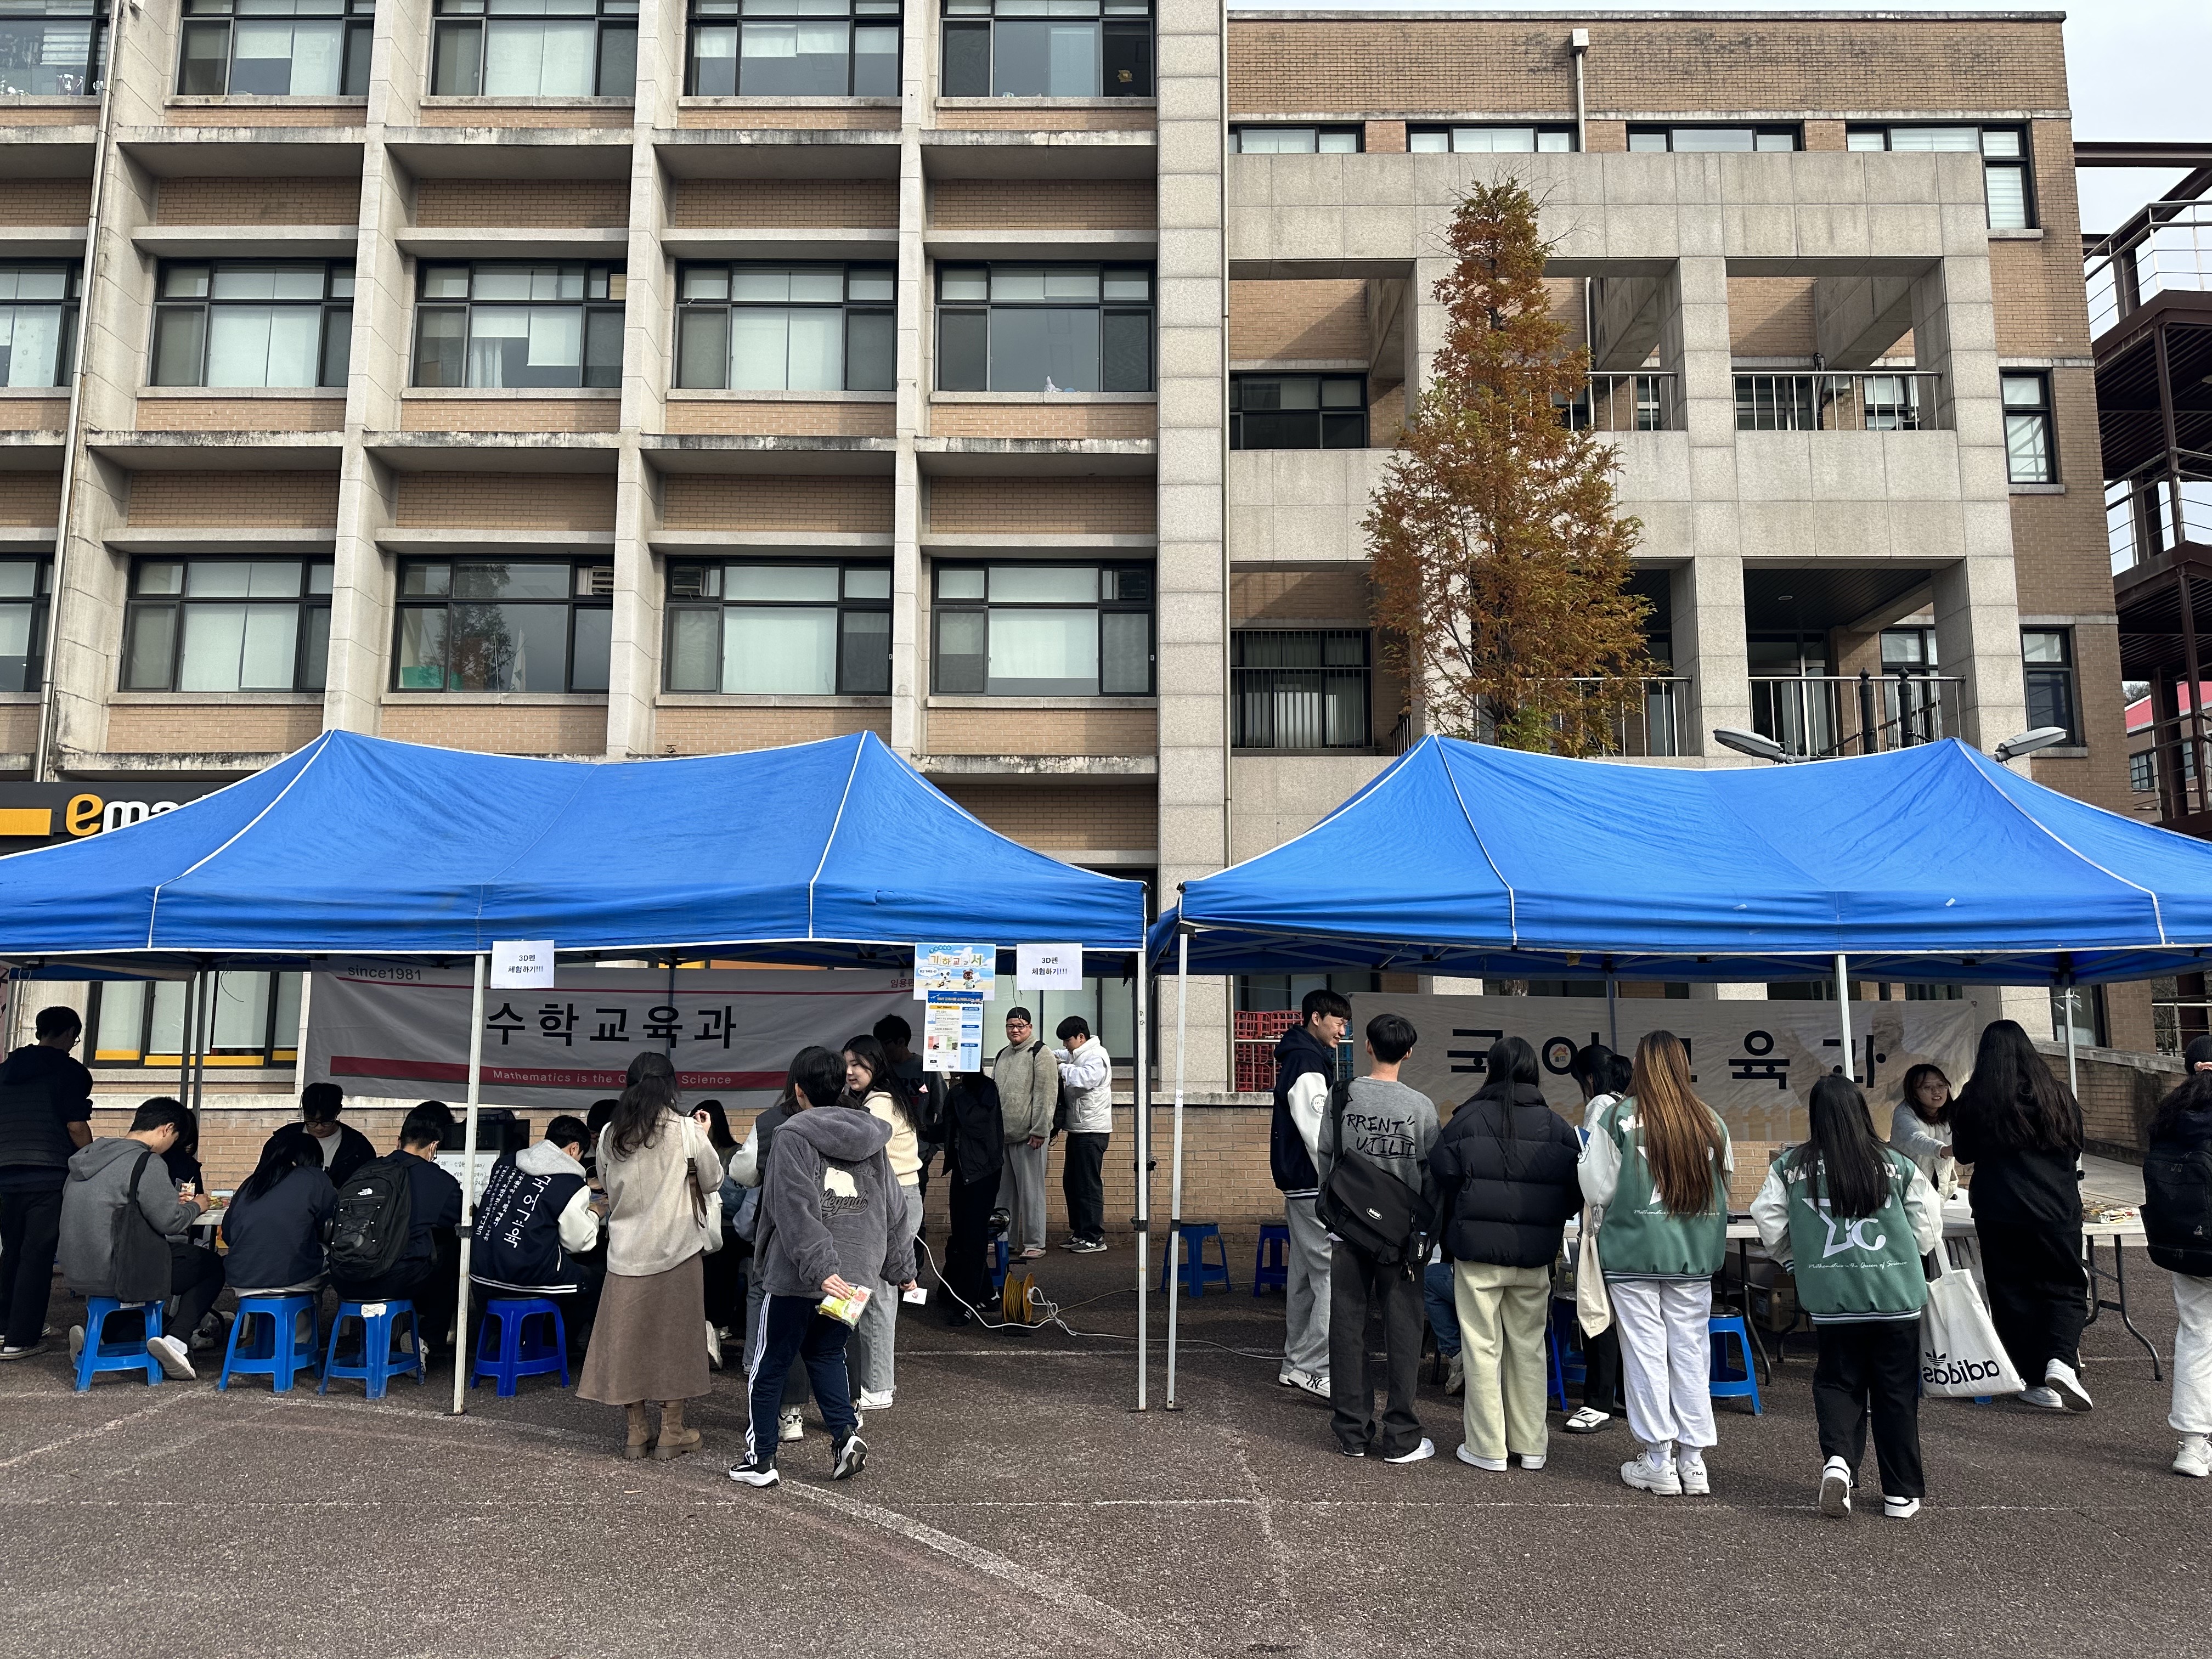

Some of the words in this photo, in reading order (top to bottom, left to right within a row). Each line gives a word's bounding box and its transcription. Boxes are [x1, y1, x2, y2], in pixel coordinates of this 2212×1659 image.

[348, 965, 421, 981] since1981
[486, 1002, 737, 1049] 수학교육과
[494, 1070, 571, 1082] Mathematics
[577, 1073, 586, 1082] is
[592, 1073, 612, 1083] the
[681, 1075, 731, 1085] Science
[1356, 1136, 1417, 1156] UTILIT
